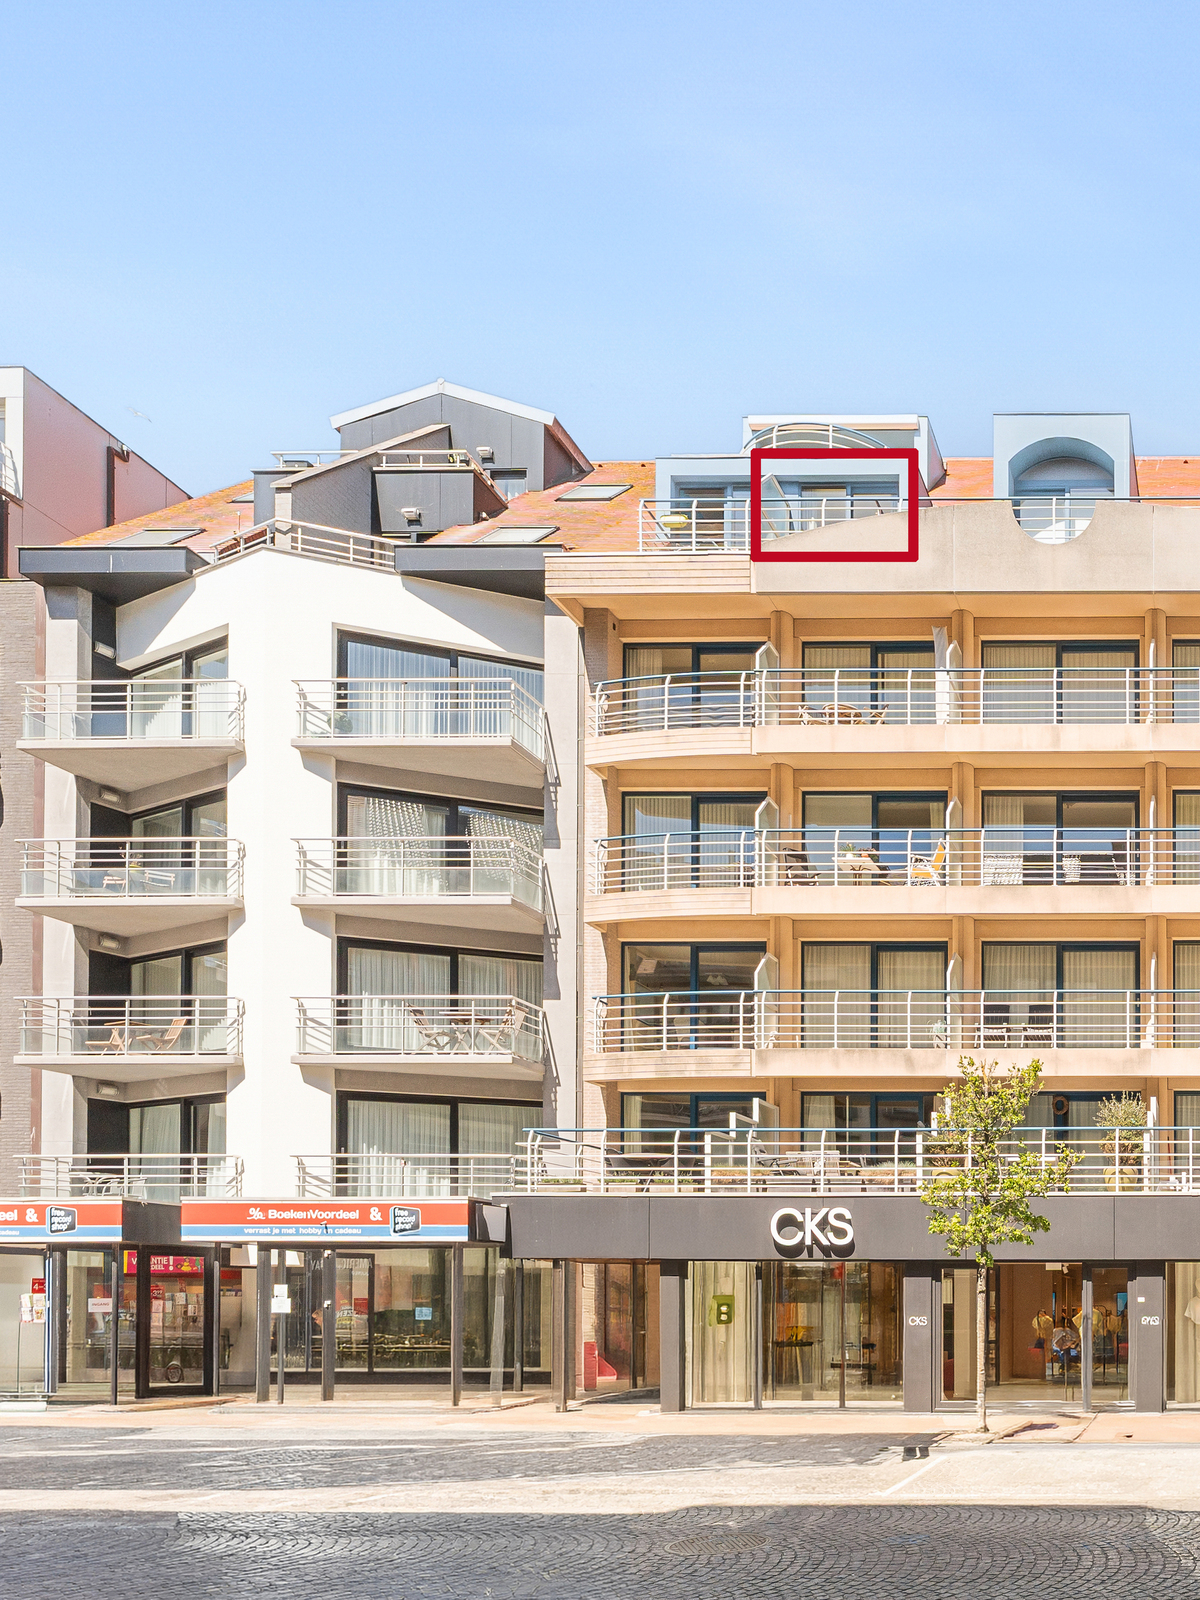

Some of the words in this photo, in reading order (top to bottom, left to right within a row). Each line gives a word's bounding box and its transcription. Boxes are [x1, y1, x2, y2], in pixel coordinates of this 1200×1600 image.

[268, 1209, 359, 1219] BoekenVoordeel
[272, 1227, 280, 1235] je
[299, 1227, 322, 1235] hobby
[770, 1207, 854, 1246] CKS
[909, 1316, 928, 1326] CKS
